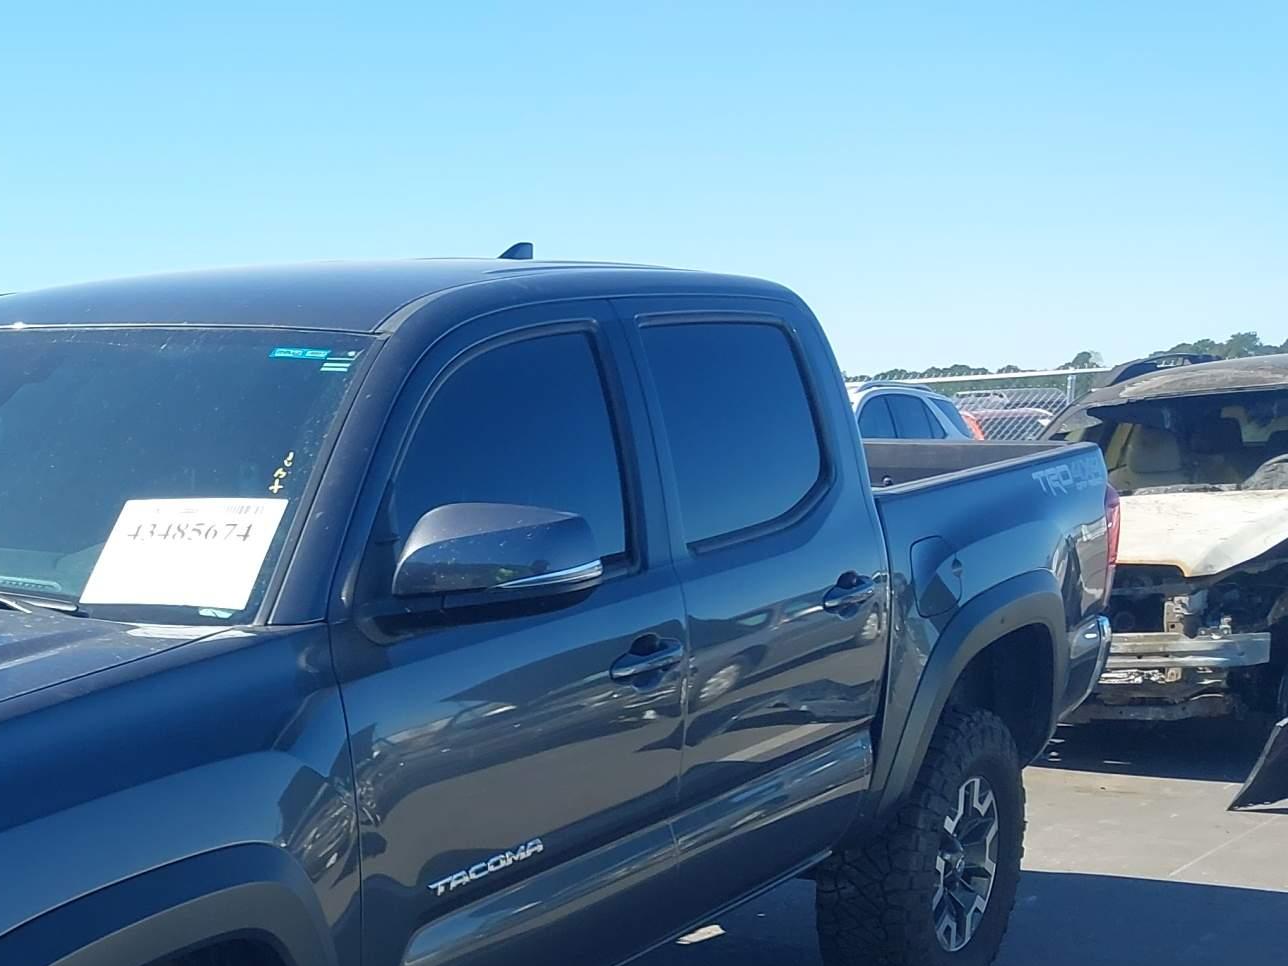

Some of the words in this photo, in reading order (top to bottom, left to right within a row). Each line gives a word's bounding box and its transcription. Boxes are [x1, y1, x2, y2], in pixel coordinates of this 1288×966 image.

[1031, 464, 1073, 496] TRD
[127, 523, 254, 542] 43485674
[428, 838, 544, 896] TACOMA
